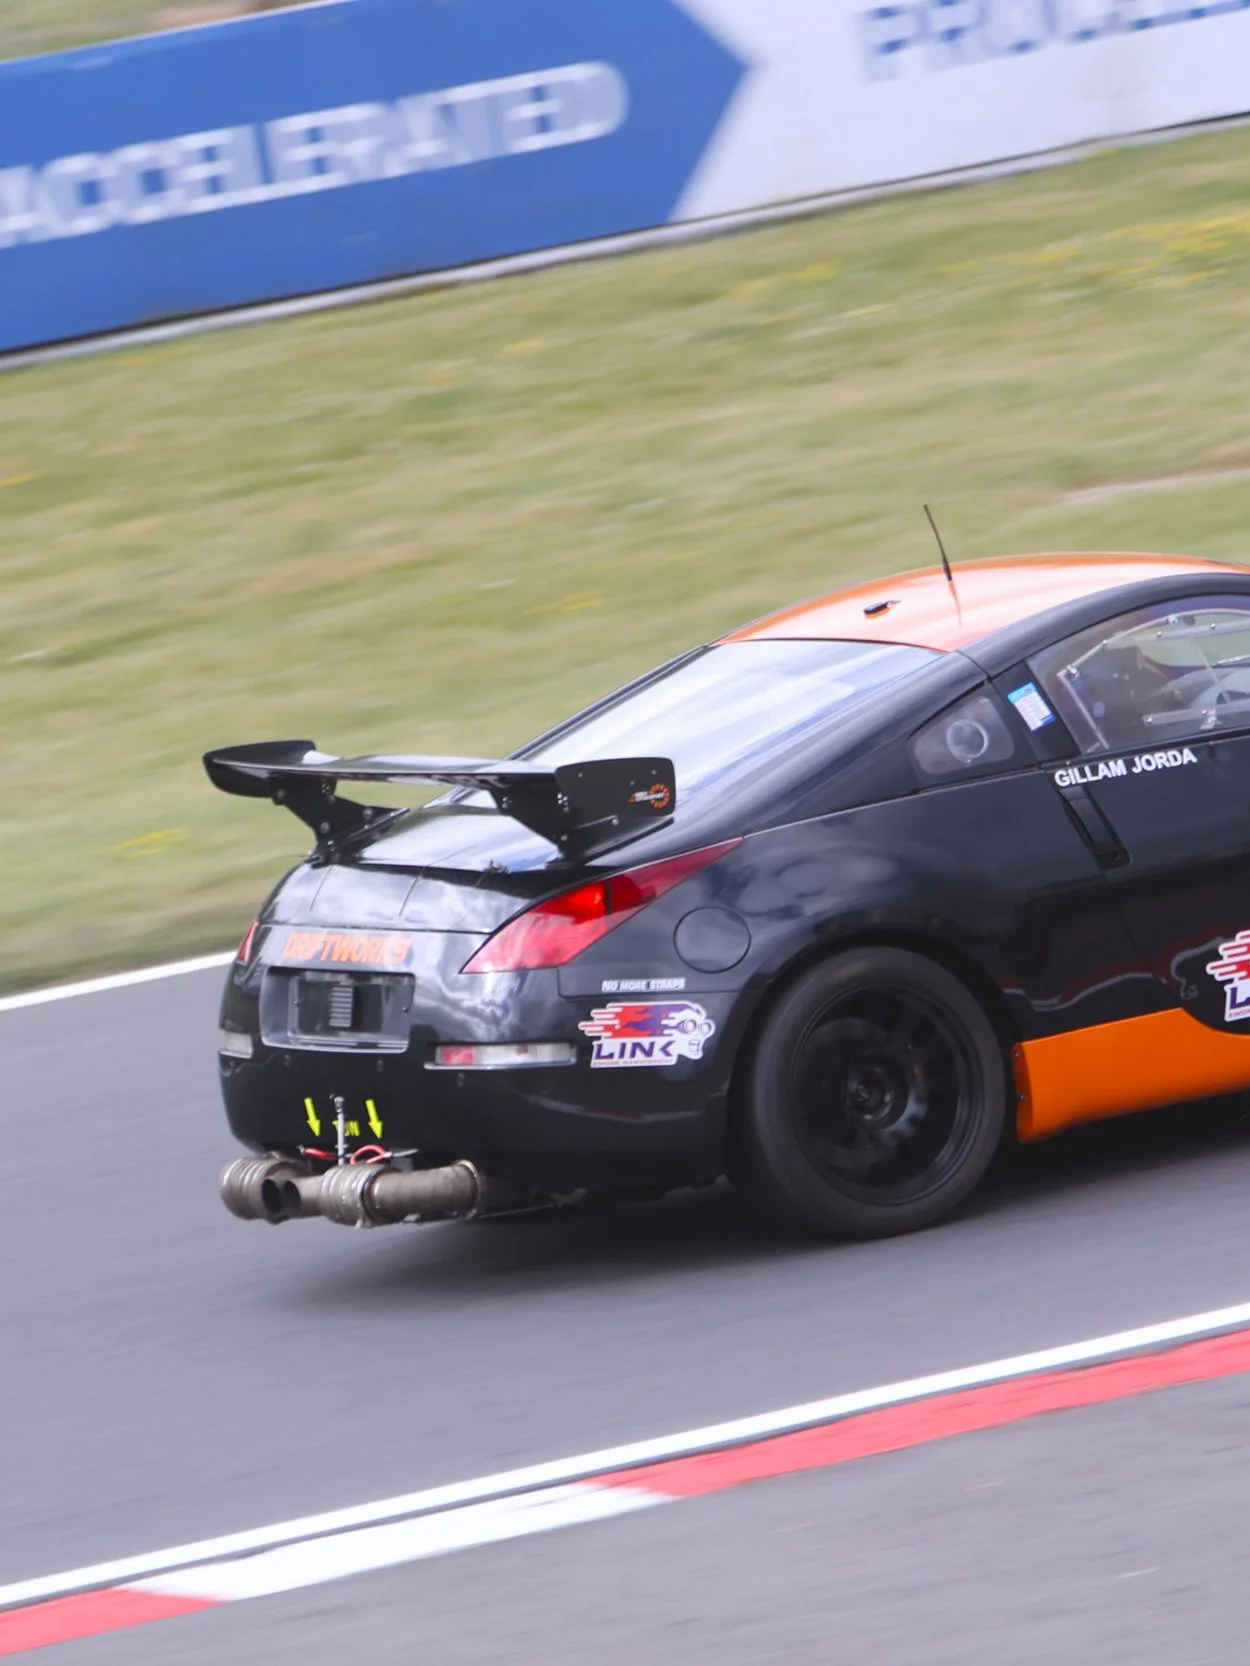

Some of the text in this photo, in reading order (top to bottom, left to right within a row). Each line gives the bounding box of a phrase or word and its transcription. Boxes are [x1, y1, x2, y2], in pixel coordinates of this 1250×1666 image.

[1054, 747, 1198, 787] GILLAM JORDA
[601, 978, 686, 992] NO MORE STRAPS
[595, 1040, 675, 1060] LINK
